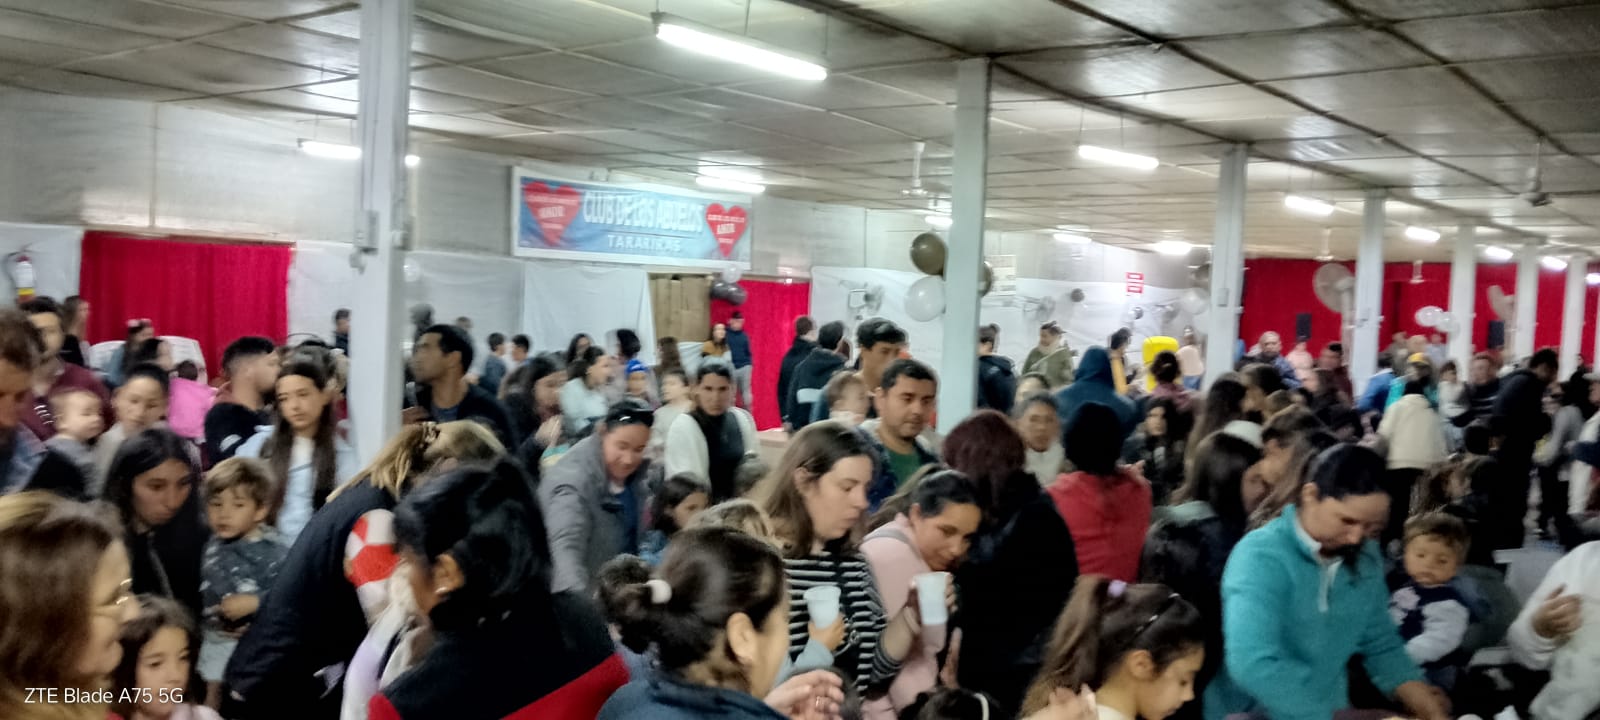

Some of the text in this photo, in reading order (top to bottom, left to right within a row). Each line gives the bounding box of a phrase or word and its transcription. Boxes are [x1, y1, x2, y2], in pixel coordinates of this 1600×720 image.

[583, 190, 613, 224] CLUB
[615, 194, 632, 226] DE
[632, 197, 656, 229] LOS
